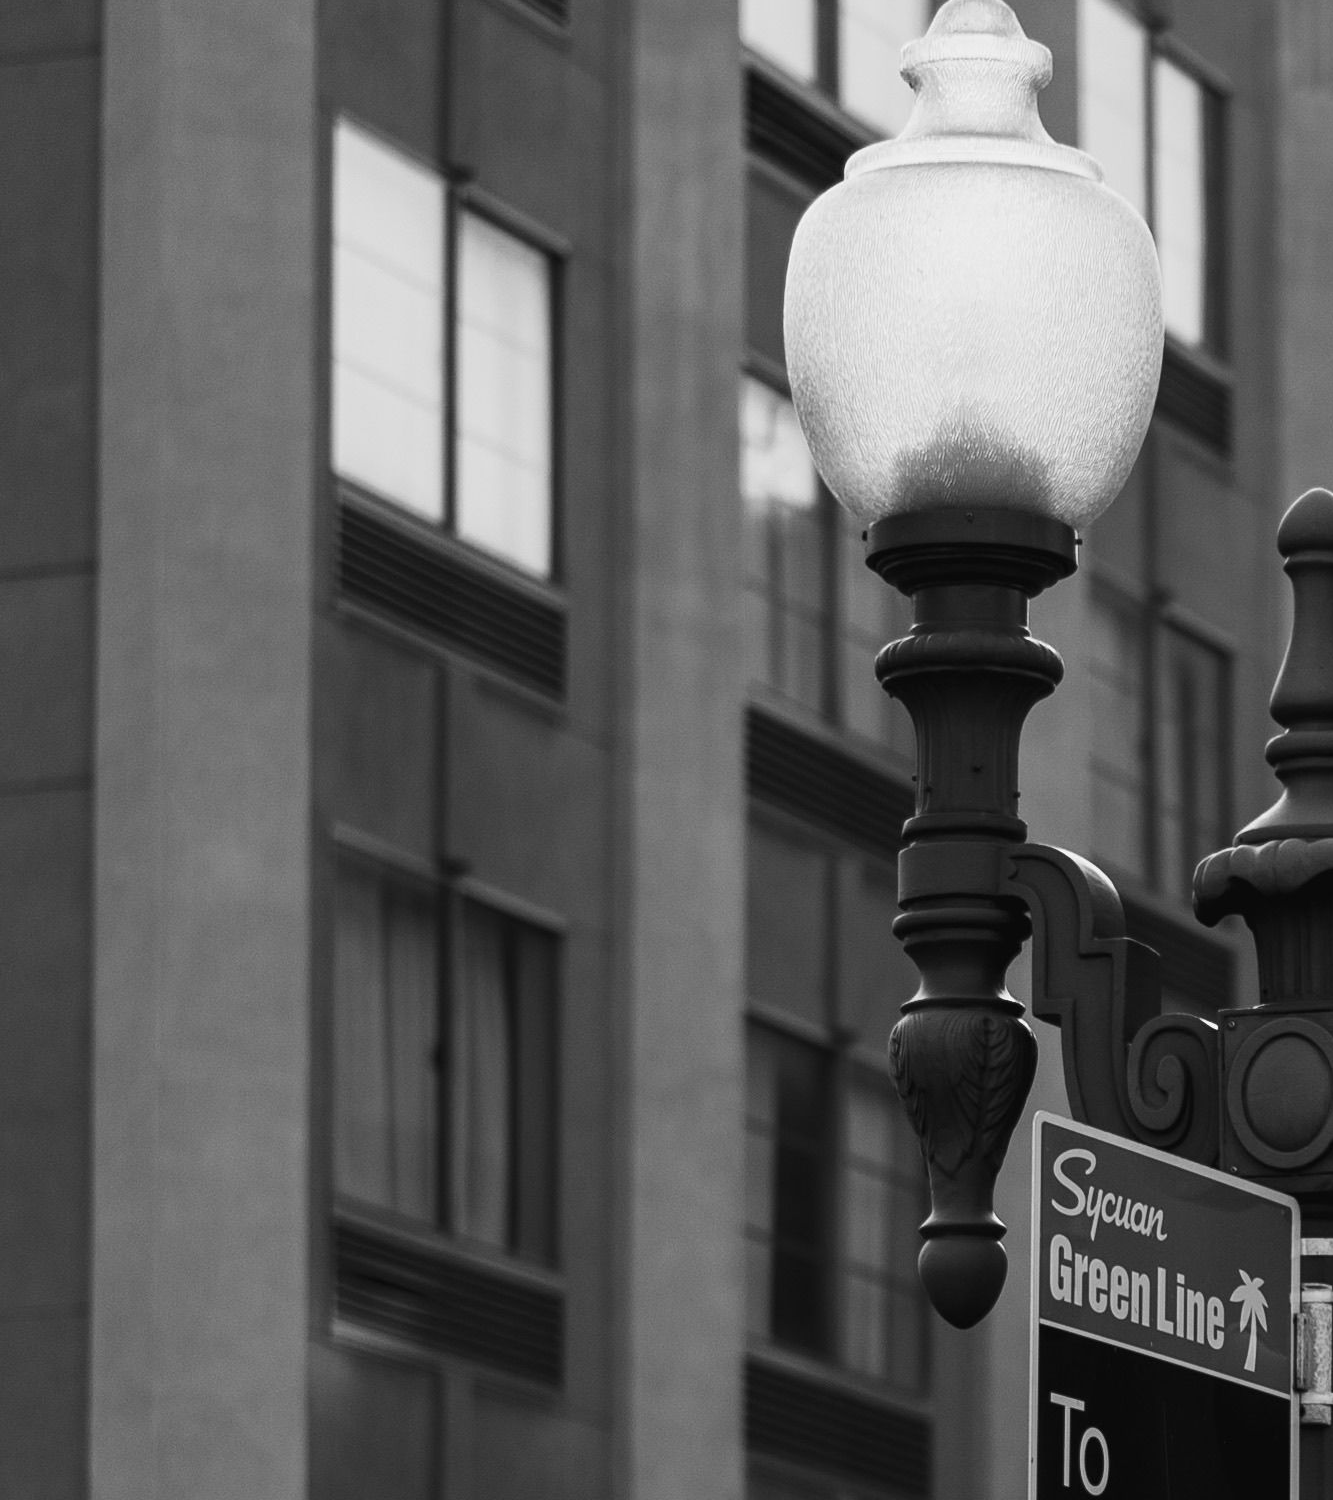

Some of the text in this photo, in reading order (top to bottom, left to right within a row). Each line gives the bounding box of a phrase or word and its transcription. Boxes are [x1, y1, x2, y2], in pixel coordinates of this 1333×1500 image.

[1051, 1148, 1168, 1241] Sycuan
[1050, 1234, 1225, 1349] Green Line
[1049, 1392, 1110, 1496] To
